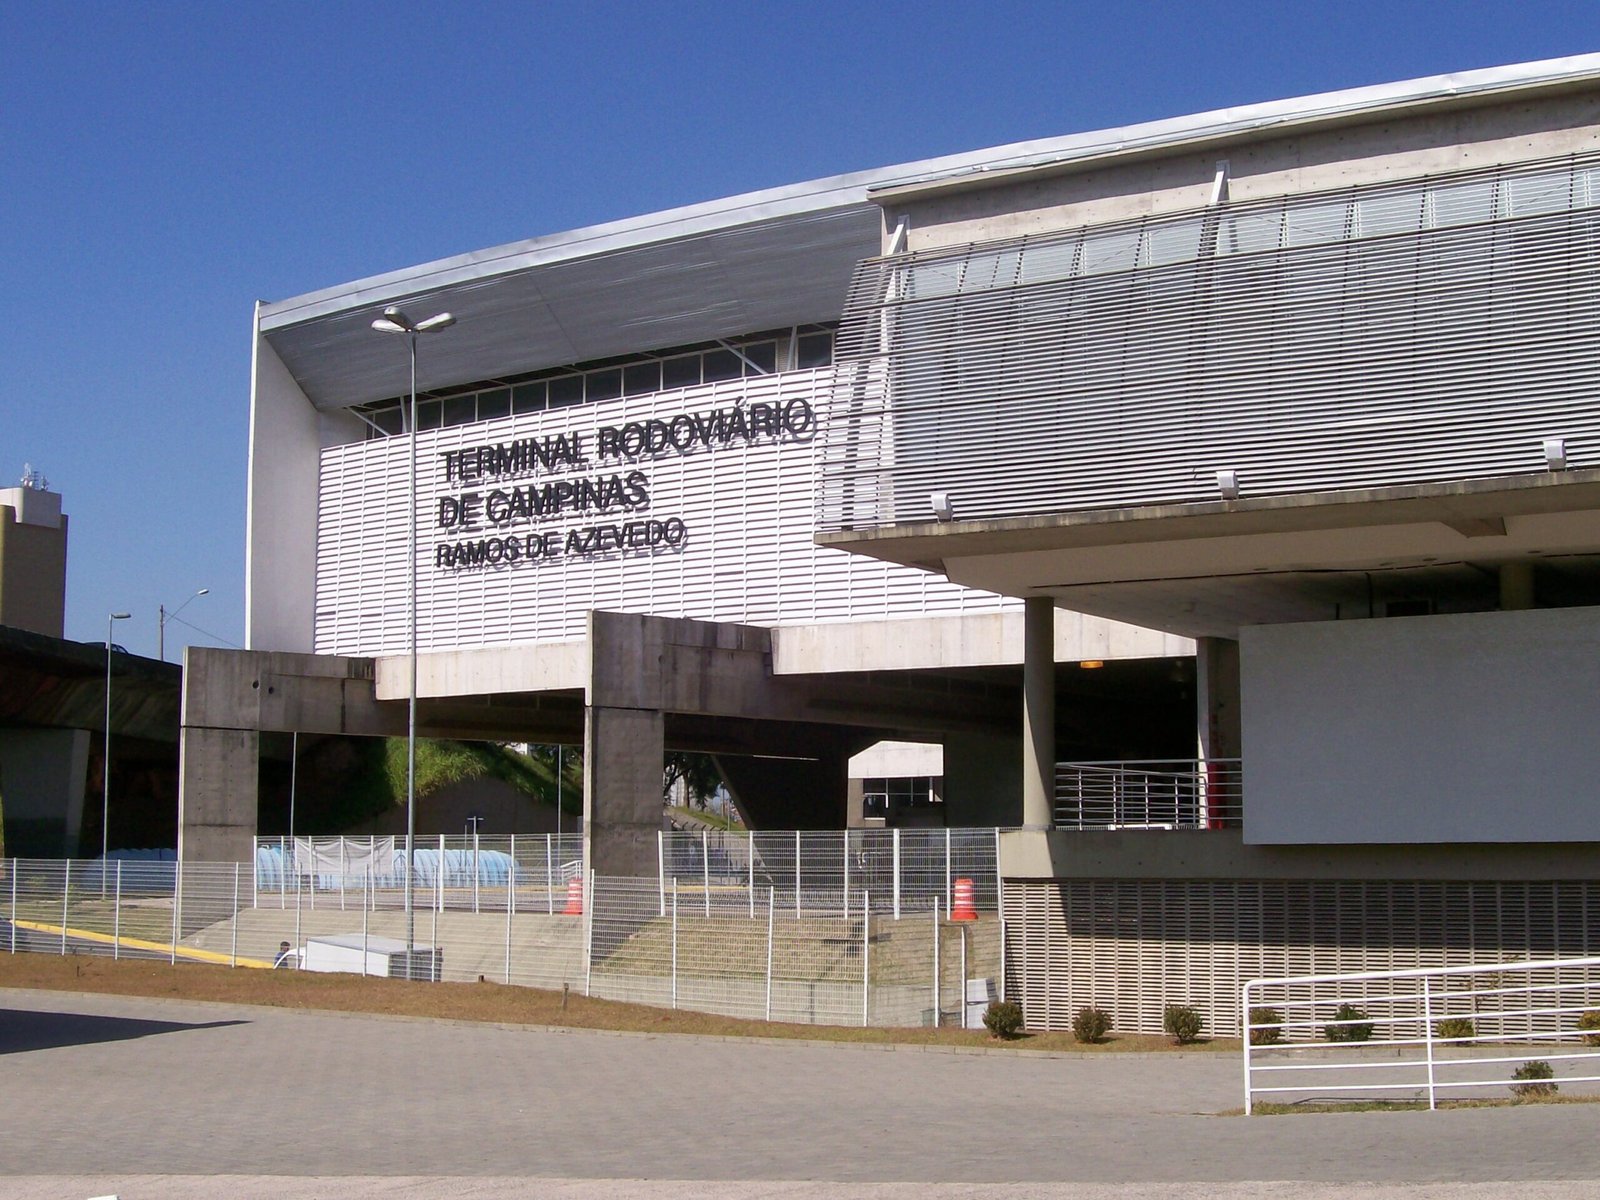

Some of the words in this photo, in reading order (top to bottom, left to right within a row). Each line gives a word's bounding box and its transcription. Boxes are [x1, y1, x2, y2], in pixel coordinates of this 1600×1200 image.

[440, 431, 589, 482] TERMINAL
[598, 396, 812, 460] RODOVIÁRIO
[438, 493, 477, 528] DE
[486, 471, 649, 523] CAMPINAS
[436, 535, 519, 568] RAMOS
[526, 531, 559, 559] DE
[564, 517, 686, 555] AZEVEDO
